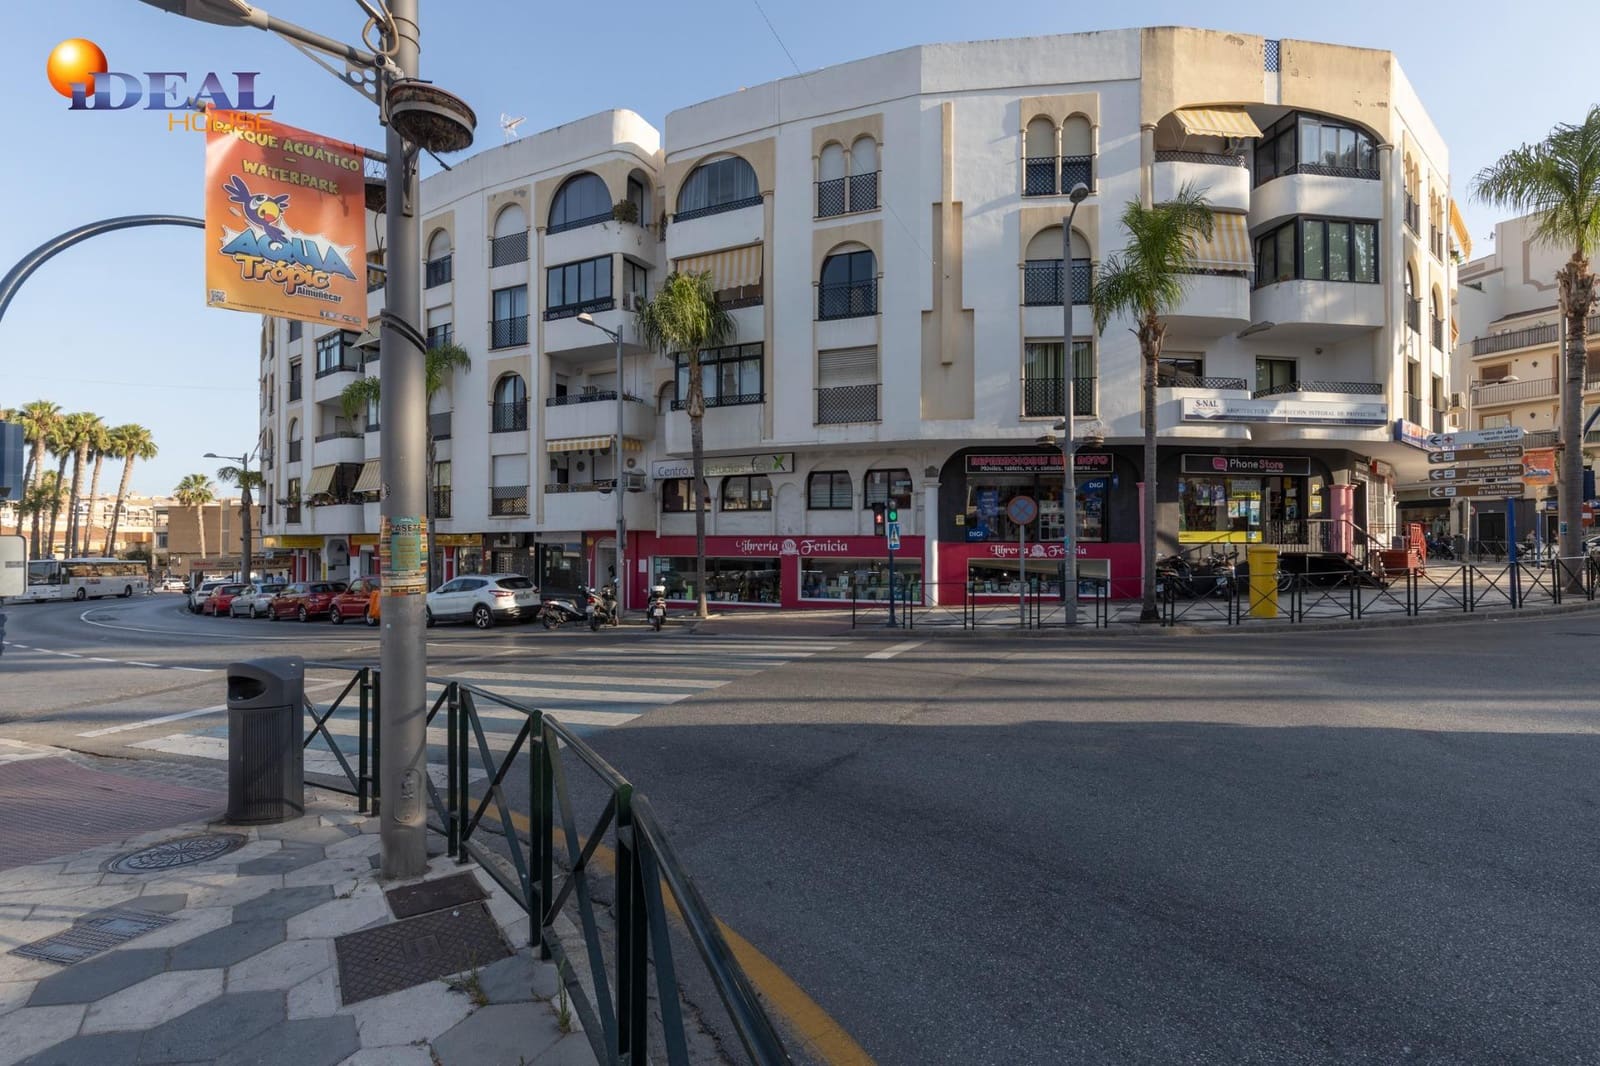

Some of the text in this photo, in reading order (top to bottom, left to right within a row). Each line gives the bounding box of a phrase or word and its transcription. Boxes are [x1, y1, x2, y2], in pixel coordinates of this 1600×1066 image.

[212, 120, 278, 149] PARQUE
[242, 159, 339, 195] WATERPARK
[220, 228, 357, 281] AQUA
[657, 466, 689, 477] Centro
[800, 539, 848, 556] Fenicia
[990, 544, 1029, 558] Librera
